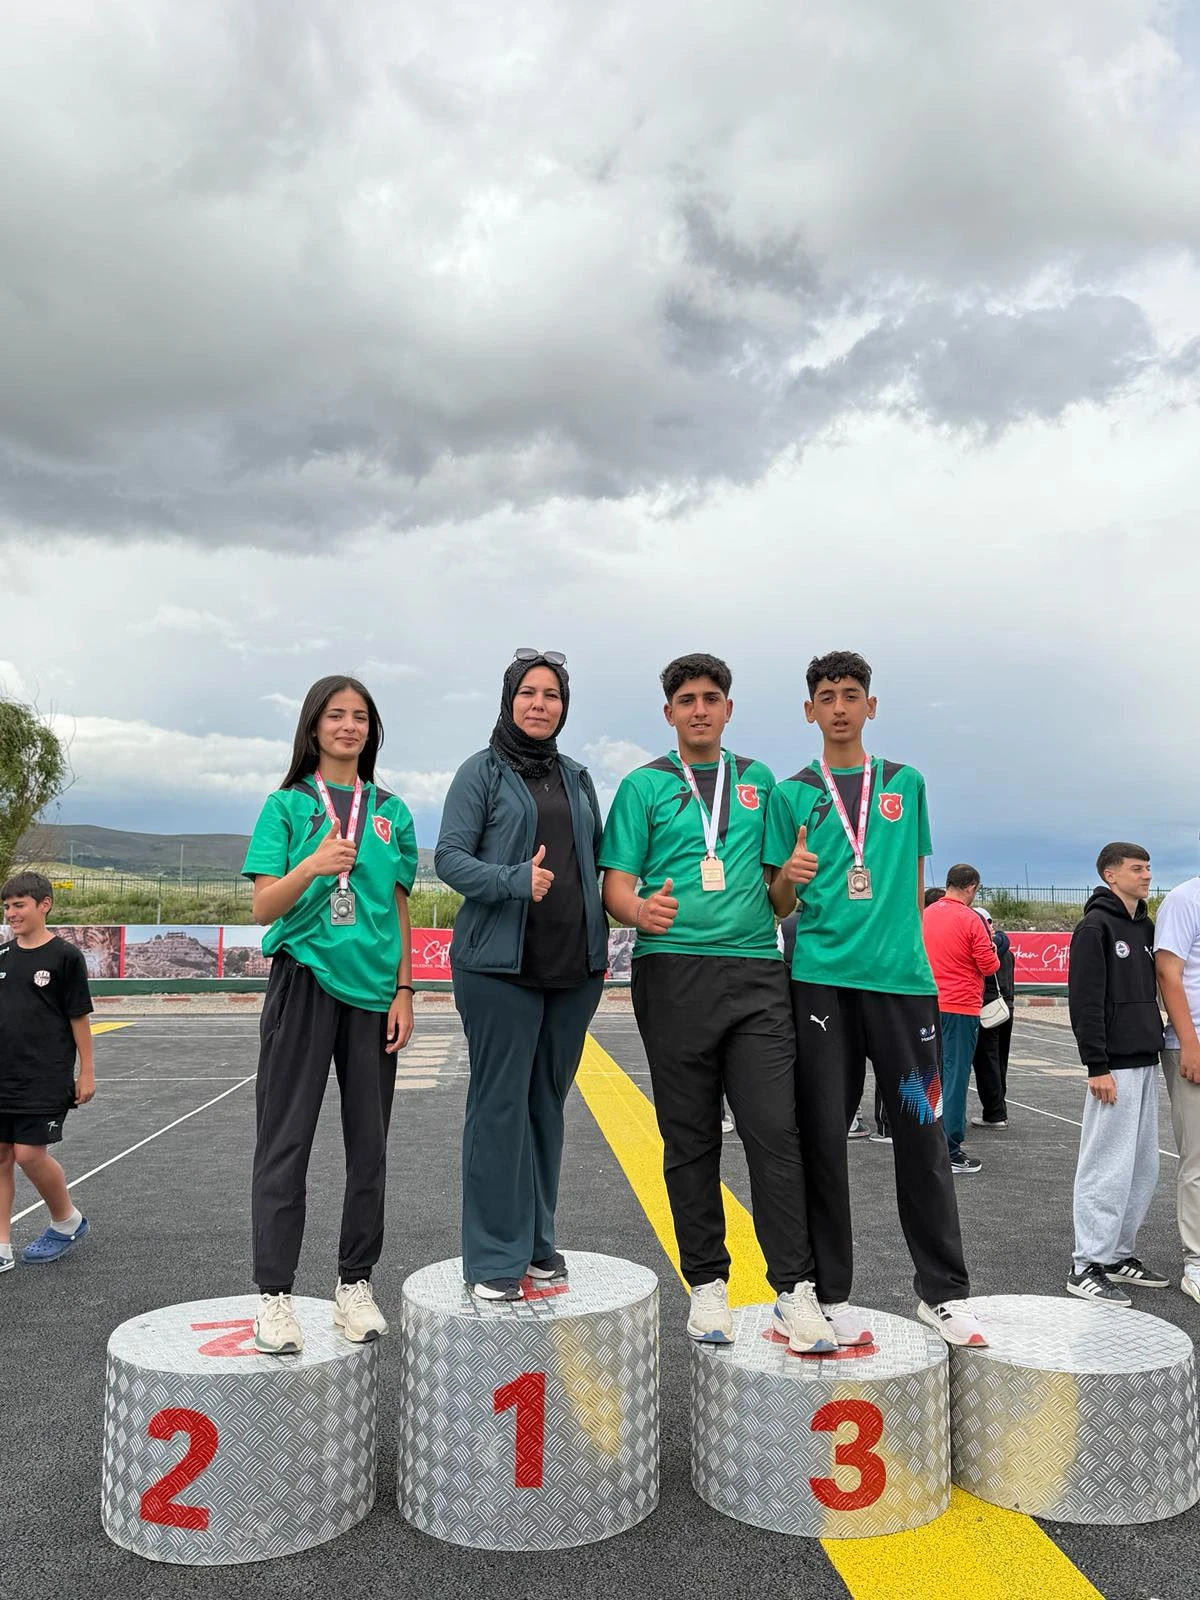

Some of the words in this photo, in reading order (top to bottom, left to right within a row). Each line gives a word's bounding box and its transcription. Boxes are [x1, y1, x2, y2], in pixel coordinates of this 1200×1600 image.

[139, 1407, 219, 1532] 2
[493, 1371, 546, 1489] 1
[808, 1399, 887, 1512] 3
